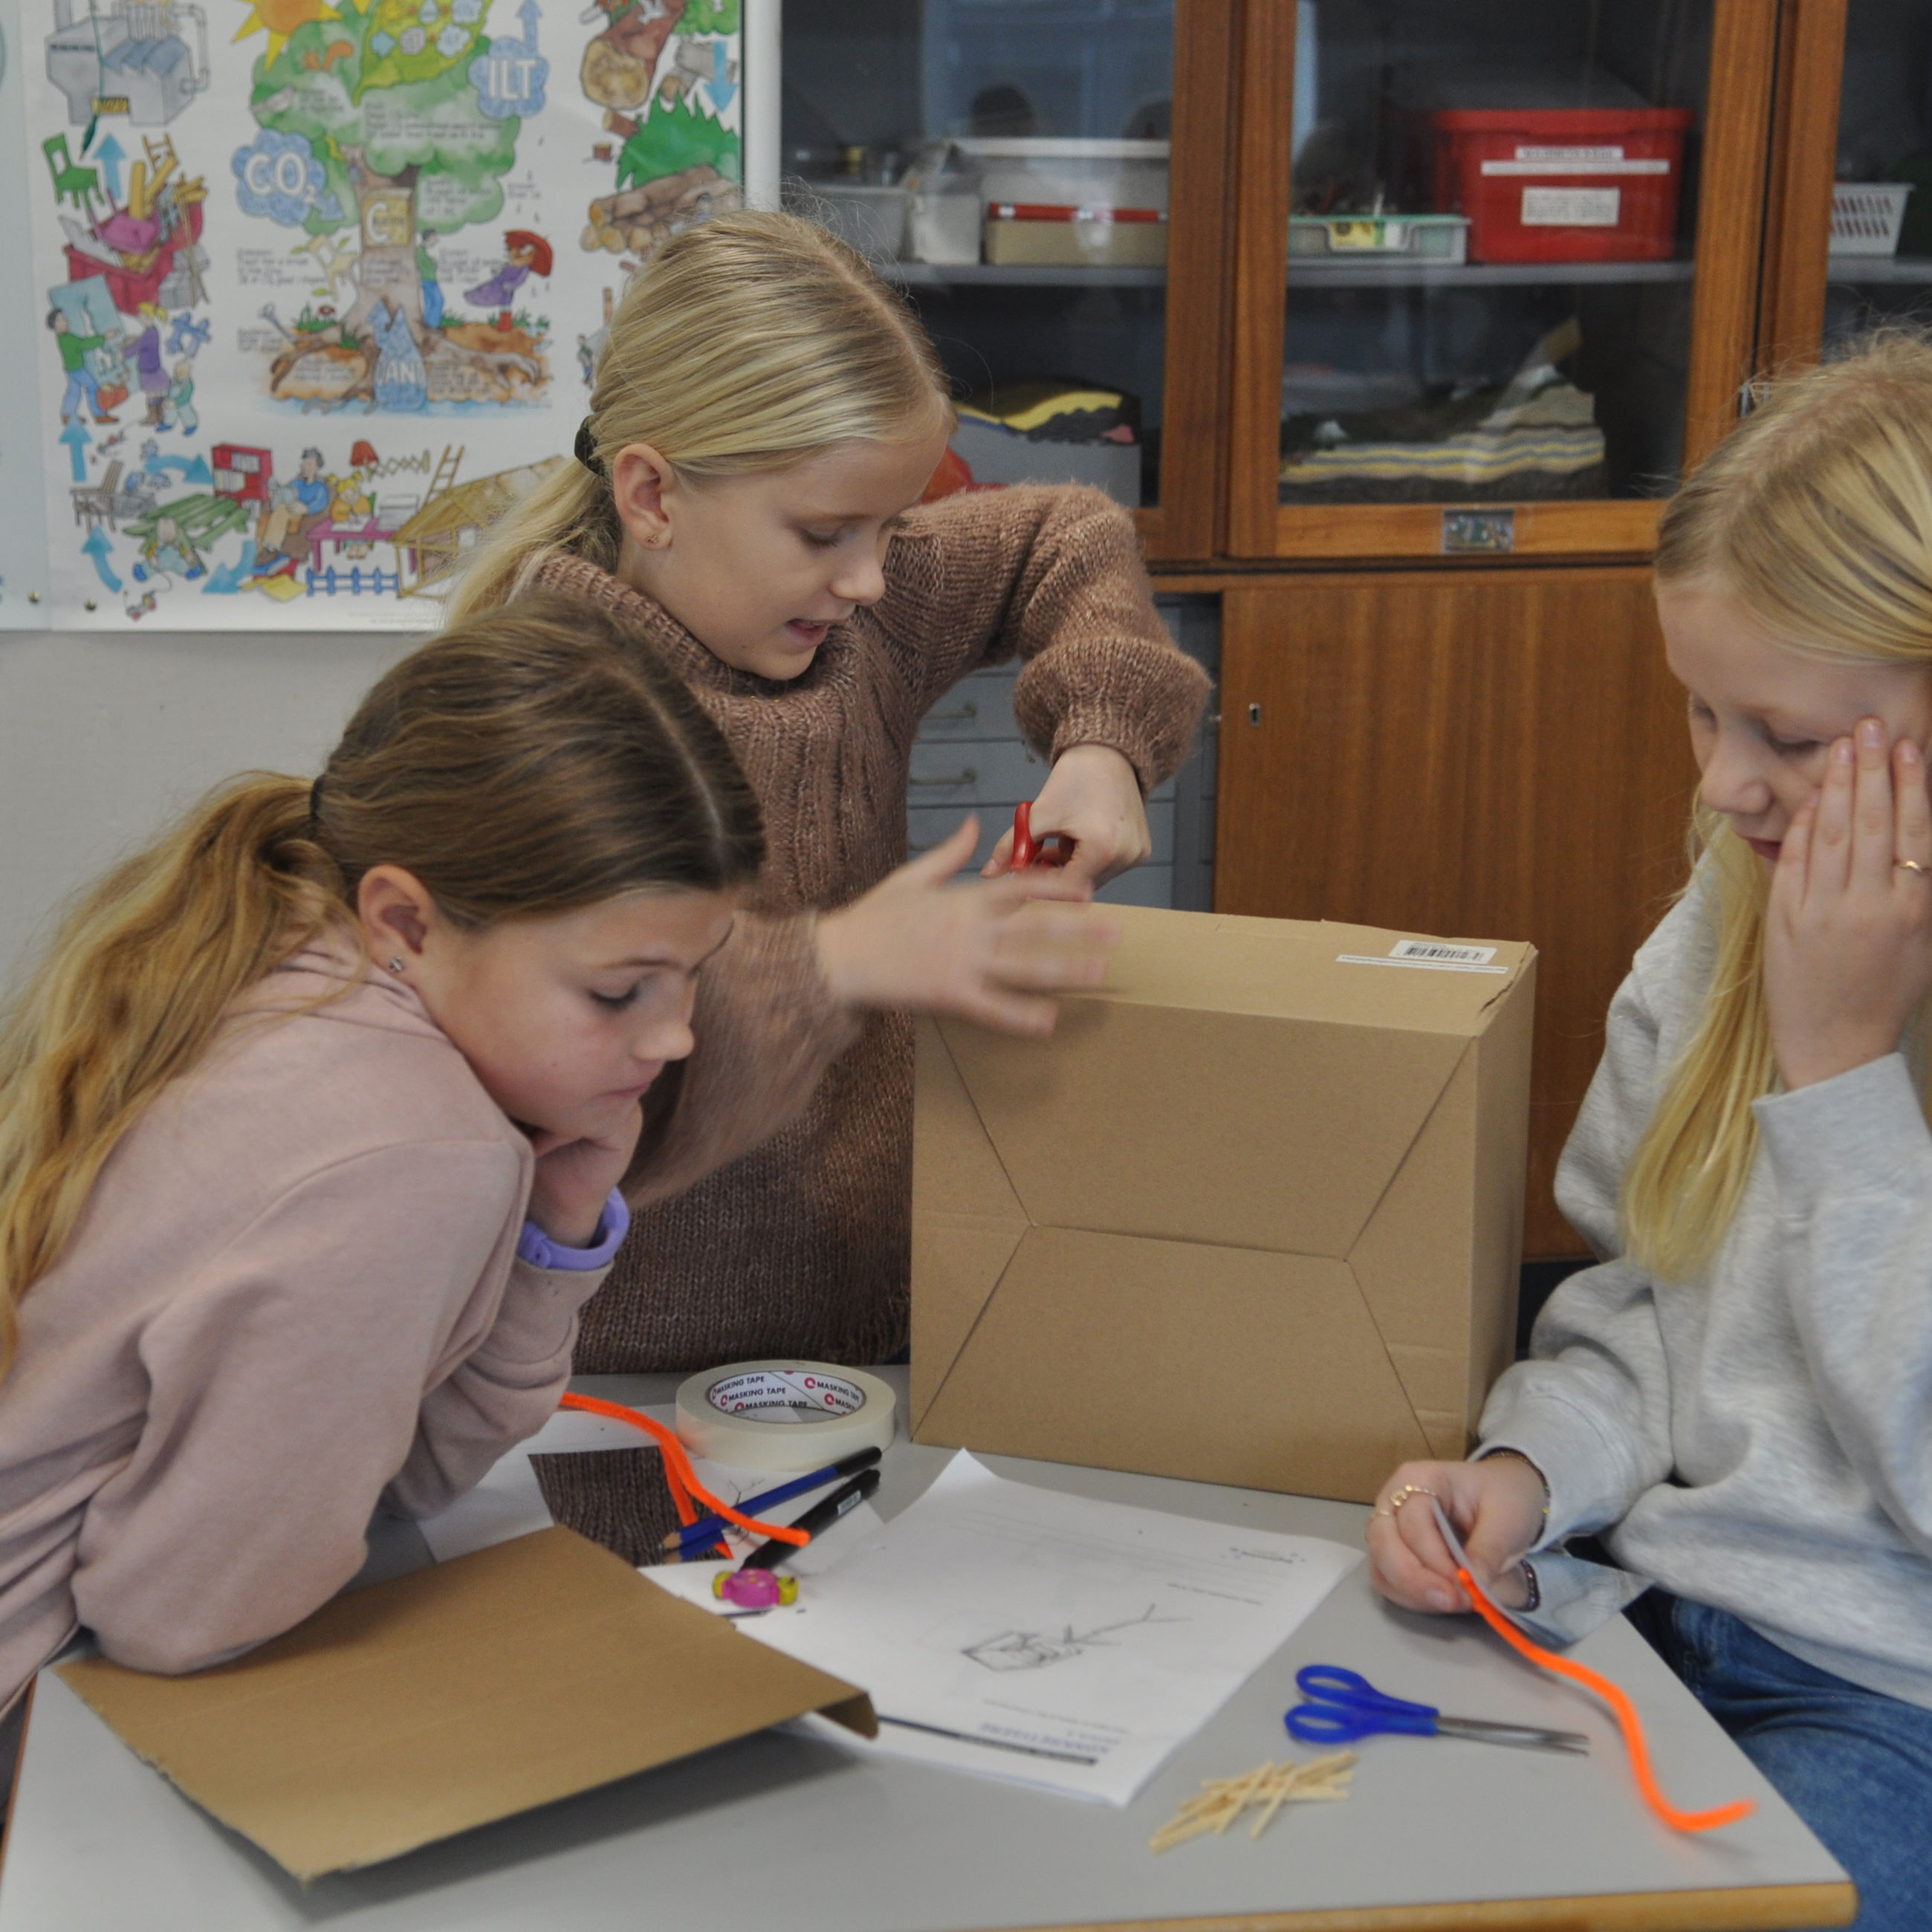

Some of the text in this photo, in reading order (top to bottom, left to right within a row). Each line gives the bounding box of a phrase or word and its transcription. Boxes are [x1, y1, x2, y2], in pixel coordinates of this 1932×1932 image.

[489, 59, 537, 101] ILT
[368, 201, 389, 242] C
[717, 1375, 765, 1394] MASKING TAPE
[816, 1381, 849, 1396] MASKING
[728, 1388, 764, 1401] MASKING
